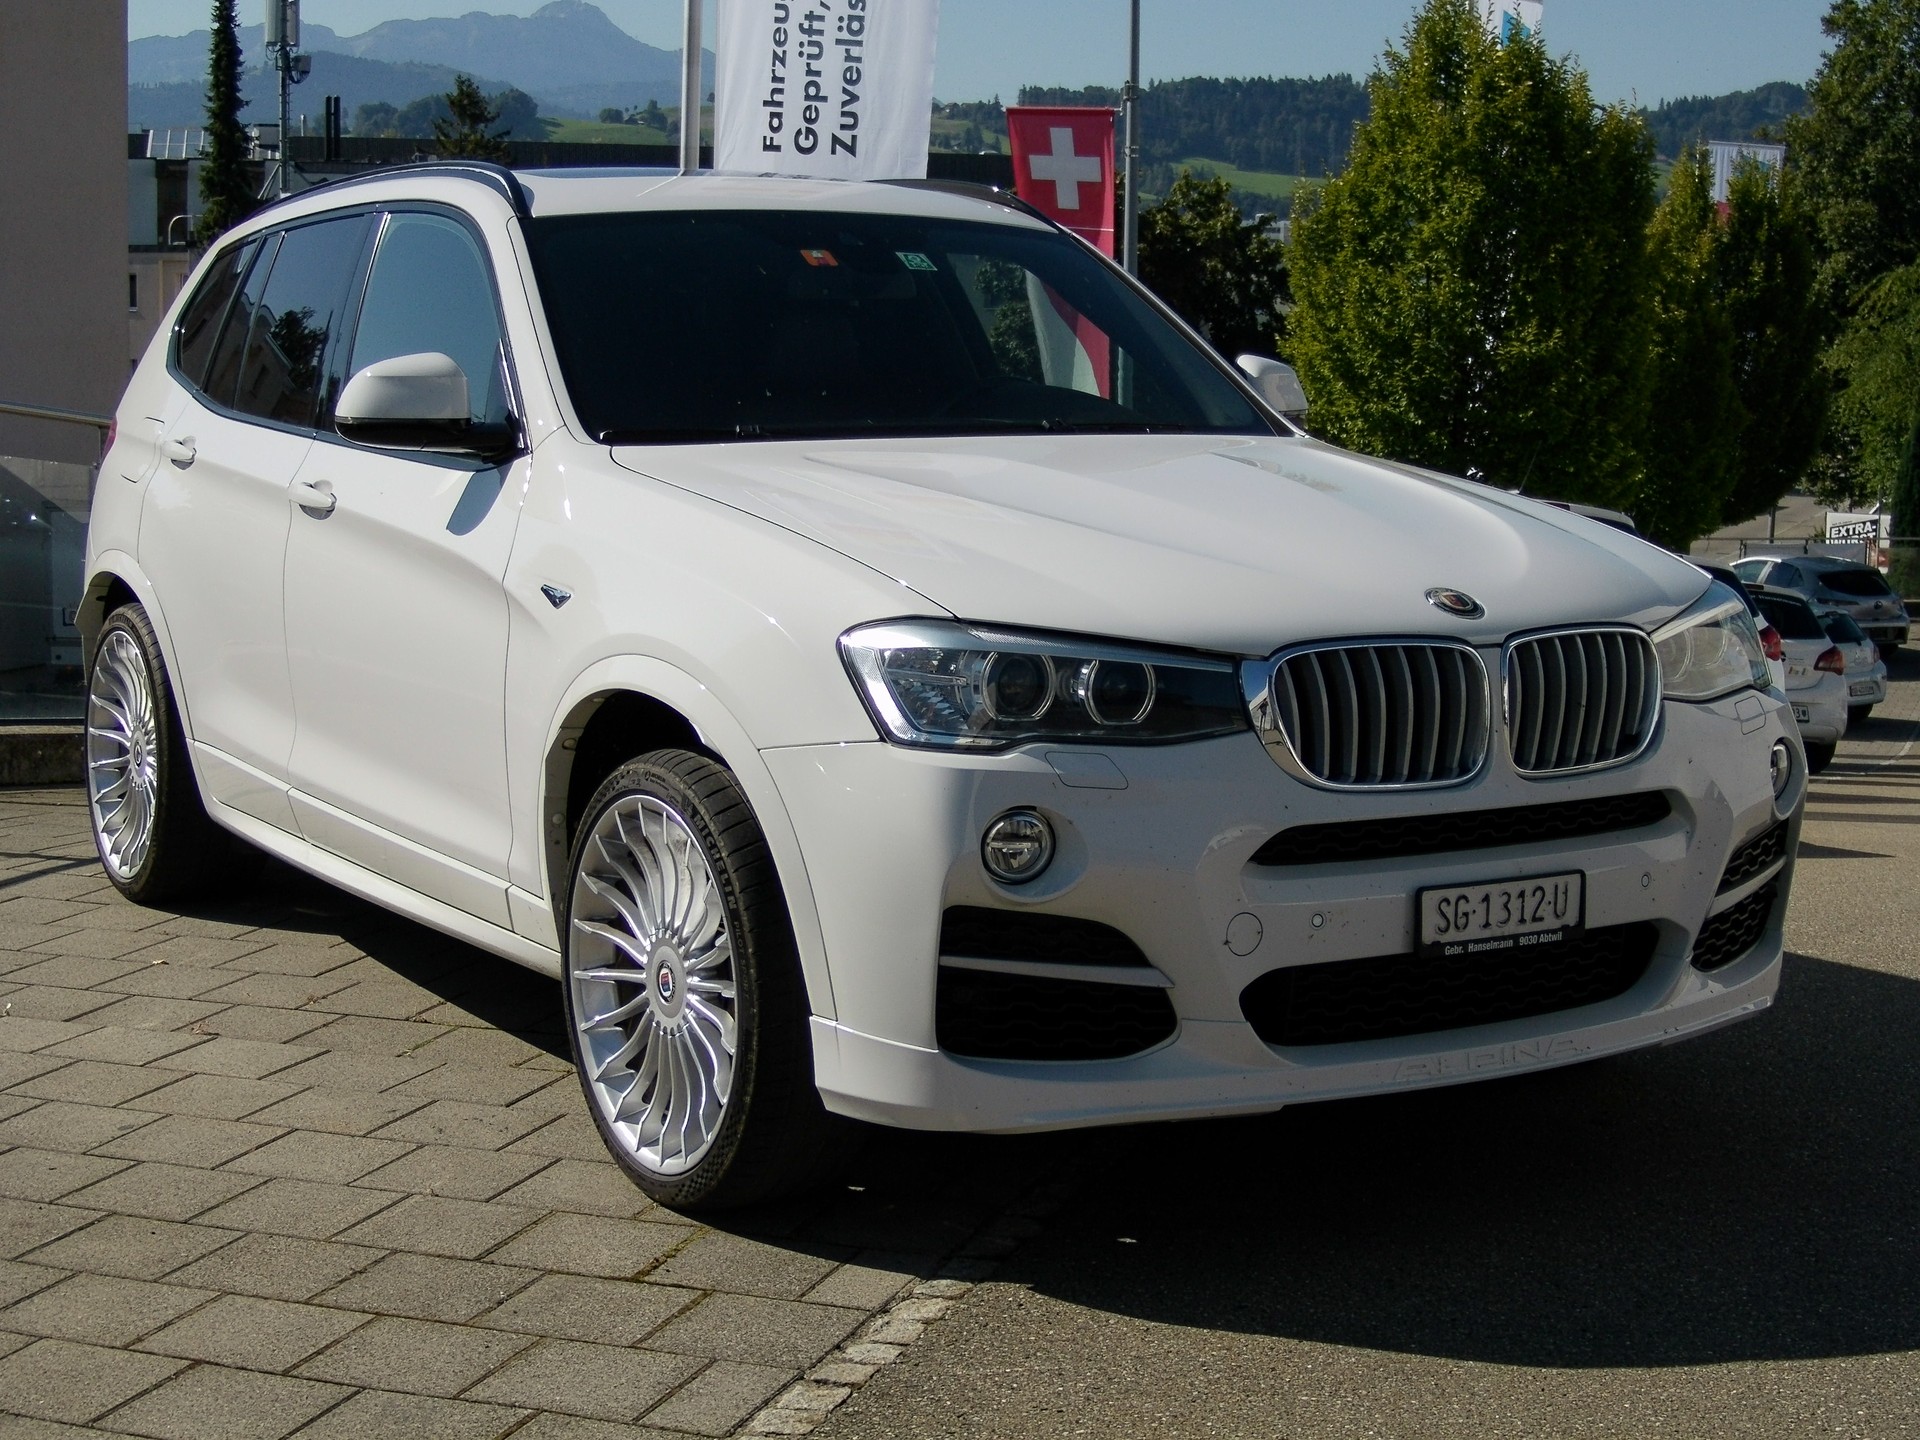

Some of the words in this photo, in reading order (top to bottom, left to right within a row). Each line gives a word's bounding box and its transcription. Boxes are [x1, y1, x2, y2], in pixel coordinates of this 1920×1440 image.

[762, 0, 791, 153] Fahrzeu
[794, 0, 831, 155] Geprüft,
[1831, 521, 1877, 538] EXTRA-
[1444, 944, 1464, 956] Gebr.
[1468, 938, 1514, 953] Hanselmann
[1519, 935, 1537, 946] 9030
[1539, 931, 1563, 943] Abtwil
